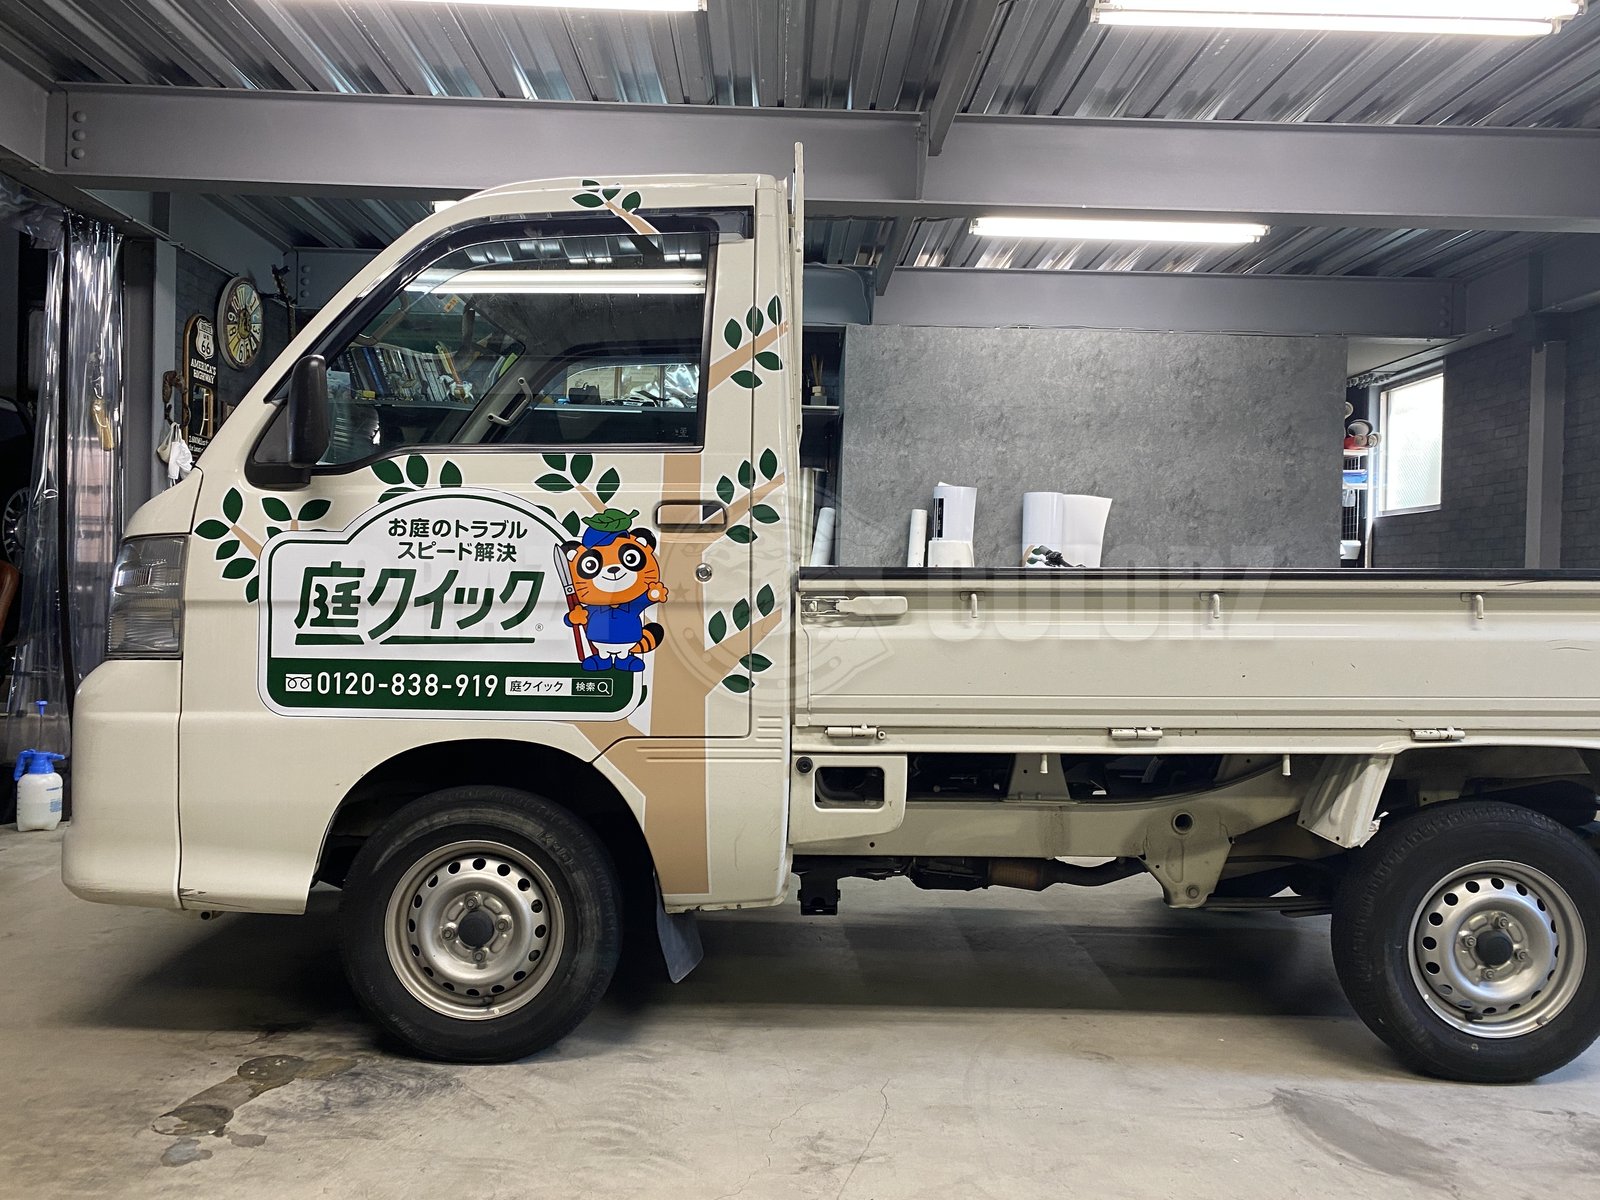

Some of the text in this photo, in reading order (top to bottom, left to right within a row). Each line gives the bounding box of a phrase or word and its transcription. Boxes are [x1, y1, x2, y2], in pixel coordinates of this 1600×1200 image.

[227, 311, 238, 322] 9
[253, 325, 261, 335] 3
[201, 340, 211, 355] 66
[190, 358, 217, 376] AMERICA'S
[388, 518, 528, 539] お庭のトラブル
[397, 541, 517, 562] スピード解決
[294, 561, 545, 641] 庭クイック
[317, 672, 596, 697] 0120-838-919 庭クイック 検索
